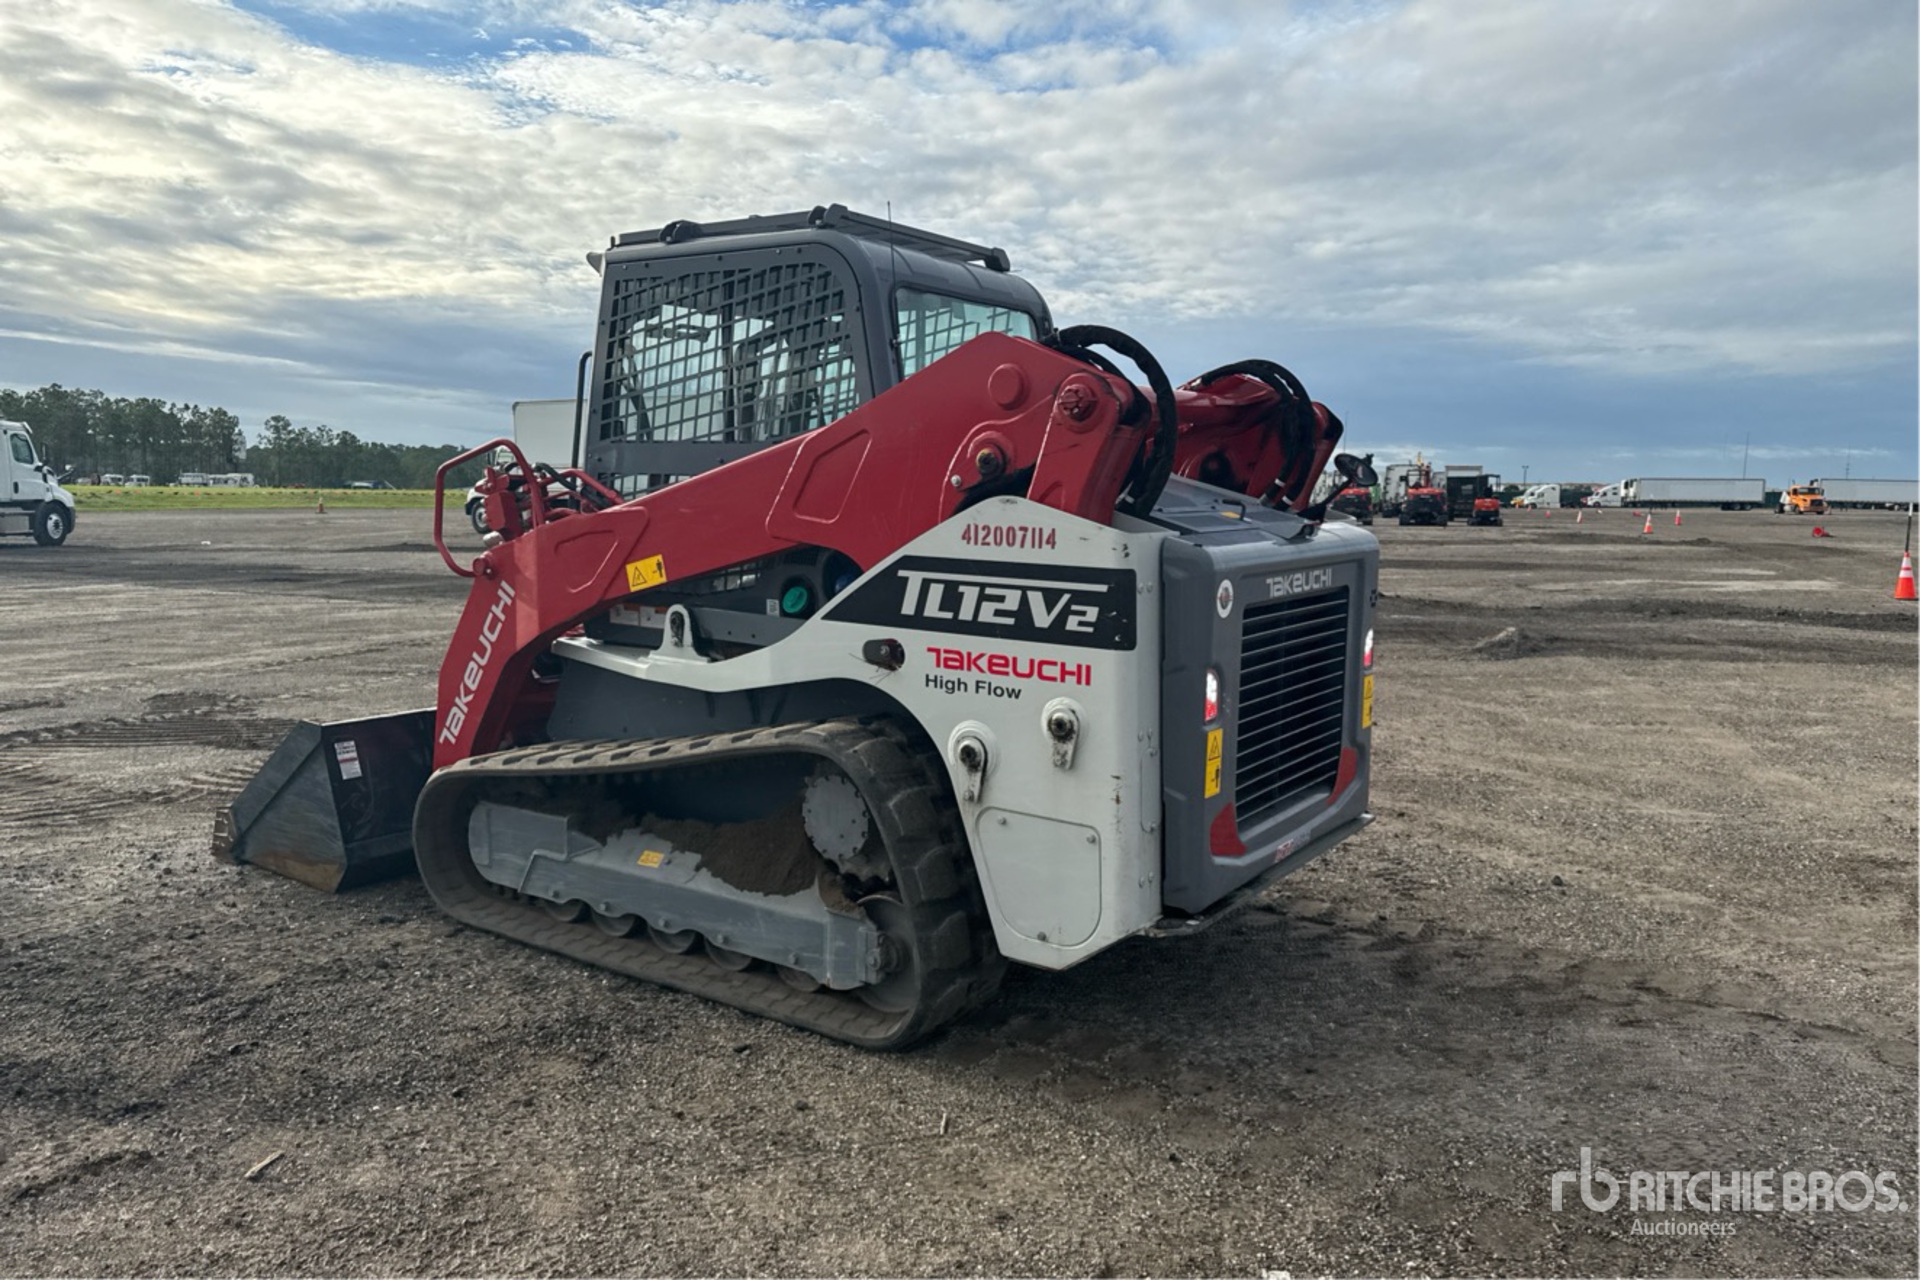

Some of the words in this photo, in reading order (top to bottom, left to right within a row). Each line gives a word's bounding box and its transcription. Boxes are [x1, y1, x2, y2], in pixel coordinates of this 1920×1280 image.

[961, 523, 1057, 549] 412007114
[1265, 568, 1333, 598] TAKEUCHI
[438, 579, 517, 746] TAKEUCHI
[926, 646, 1092, 686] TAKEUCHI
[924, 673, 968, 695] High
[974, 680, 1022, 700] Flow
